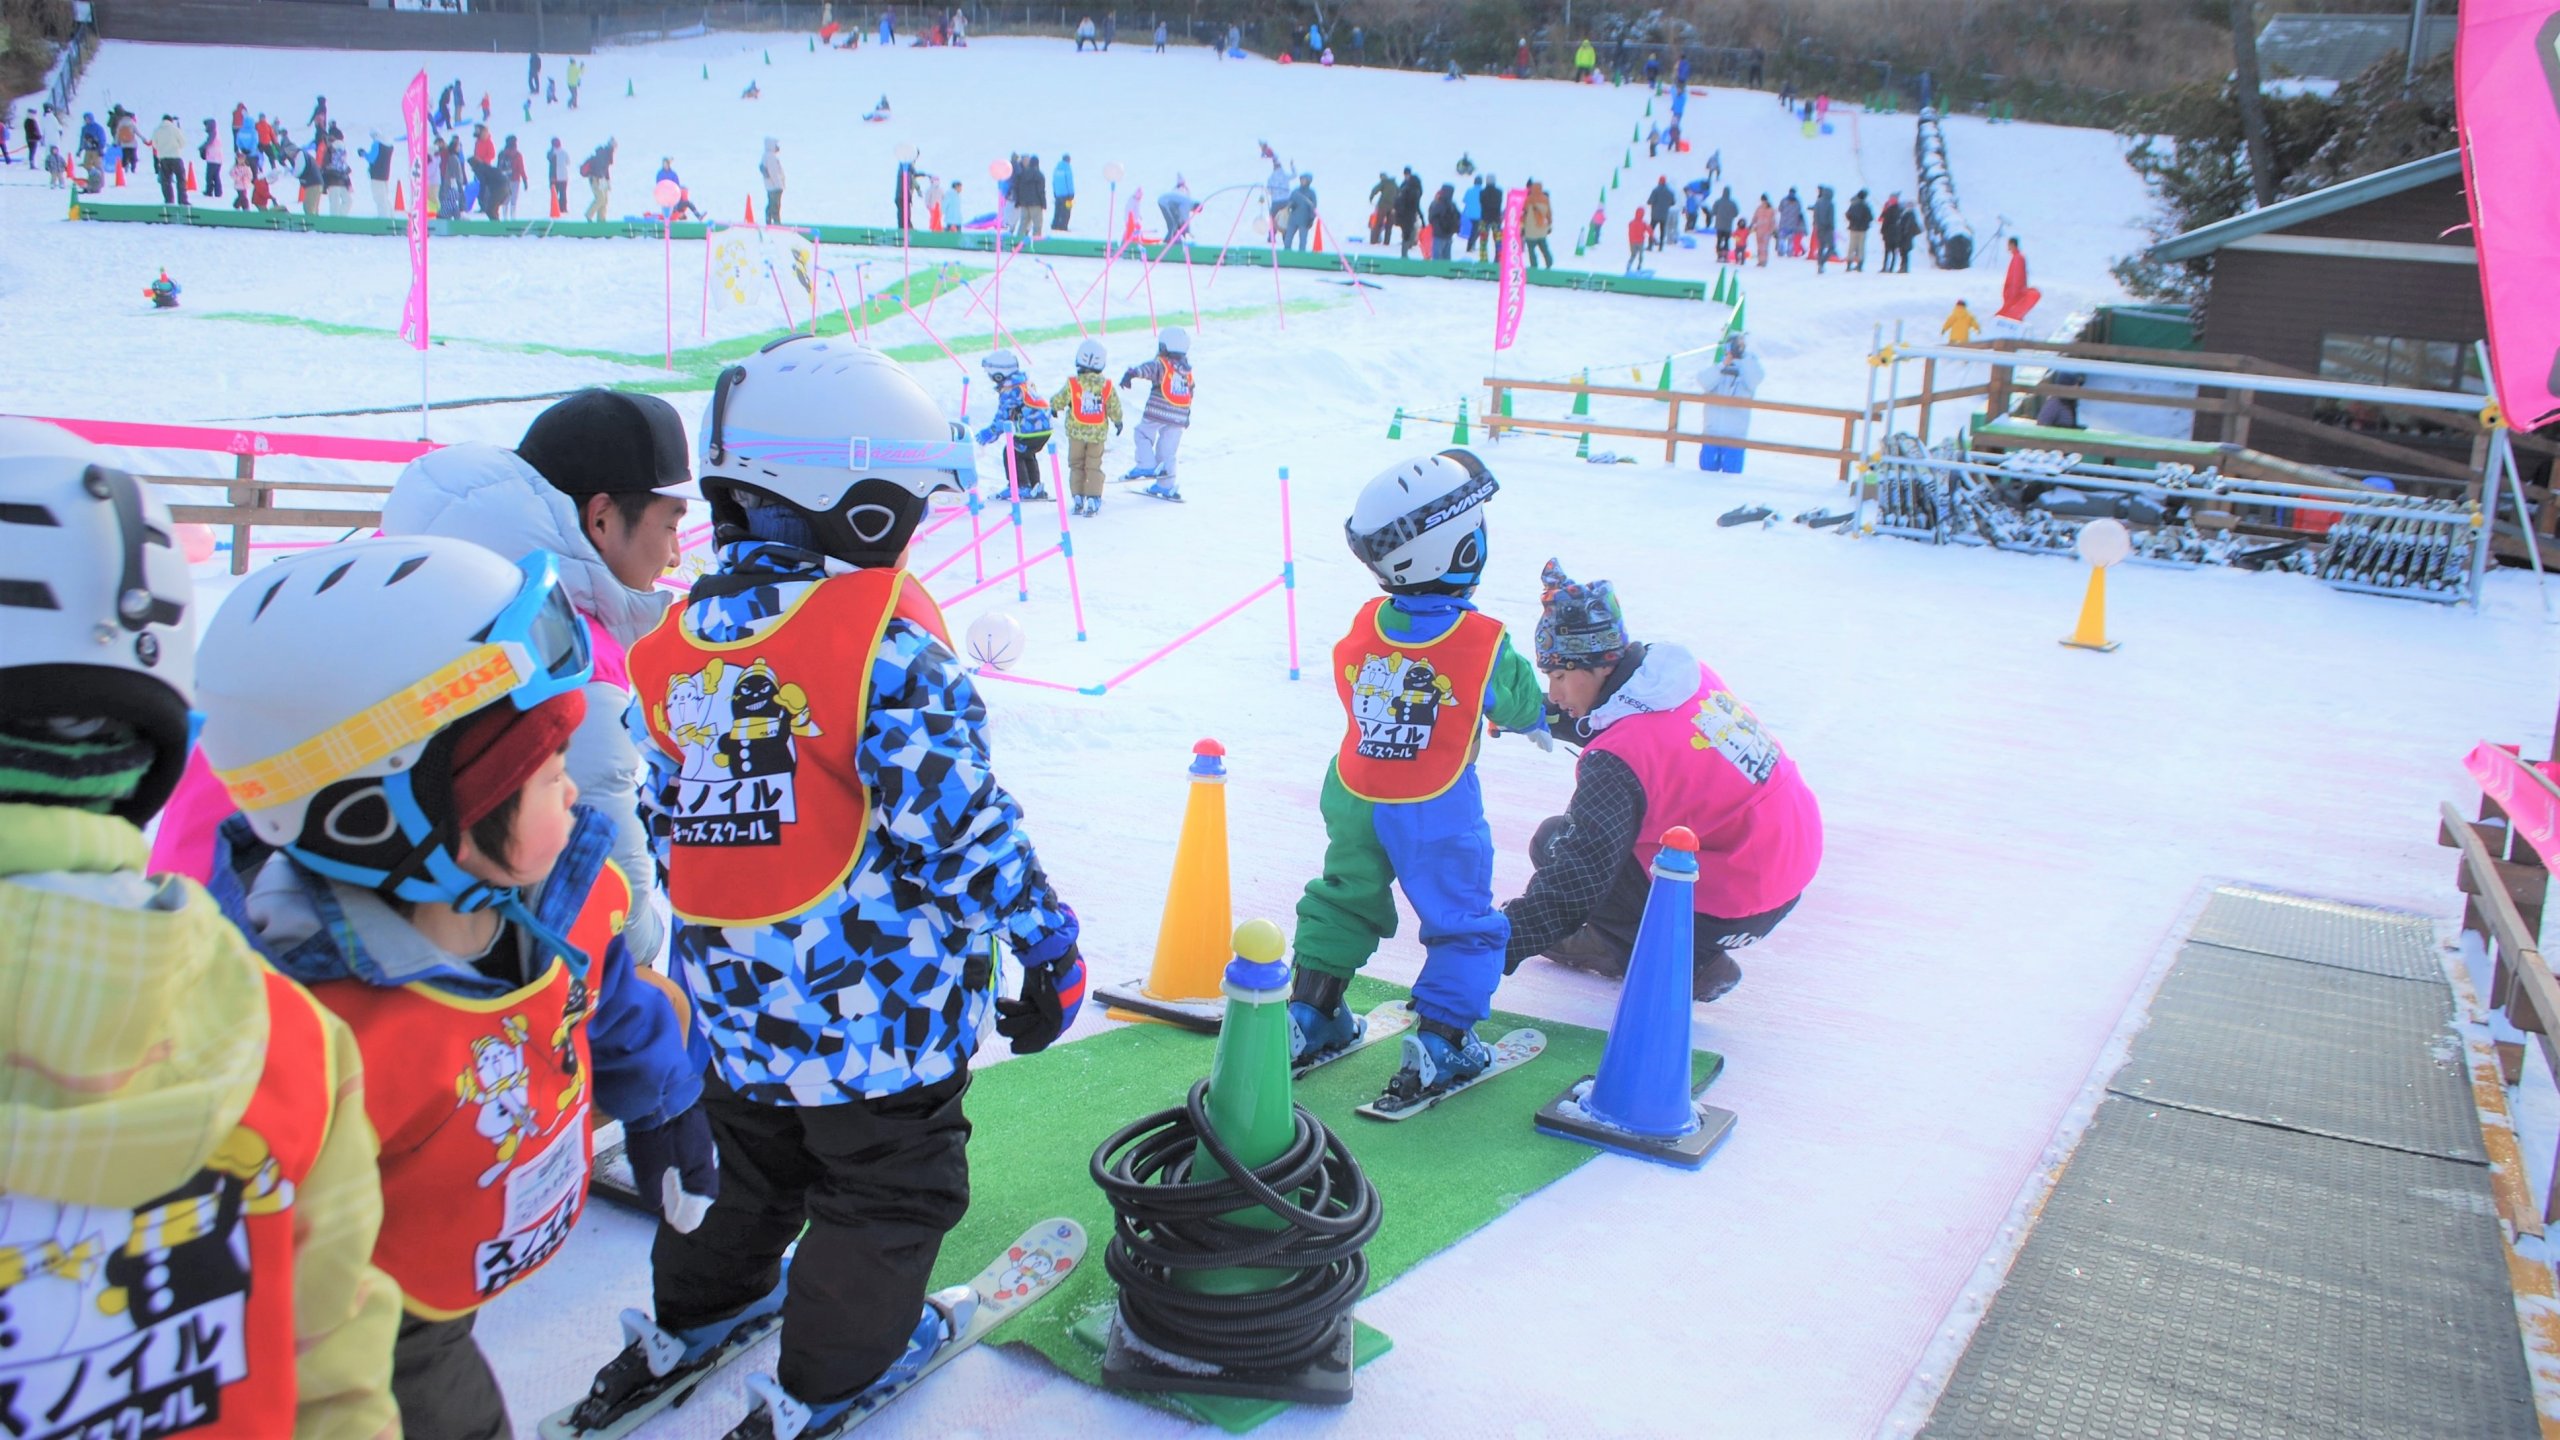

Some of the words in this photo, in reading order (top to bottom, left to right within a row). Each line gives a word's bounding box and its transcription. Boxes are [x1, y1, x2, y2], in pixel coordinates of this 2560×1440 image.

[1424, 480, 1494, 530] SWANS
[676, 778, 783, 815] ノイル
[672, 819, 773, 843] キッズスクール
